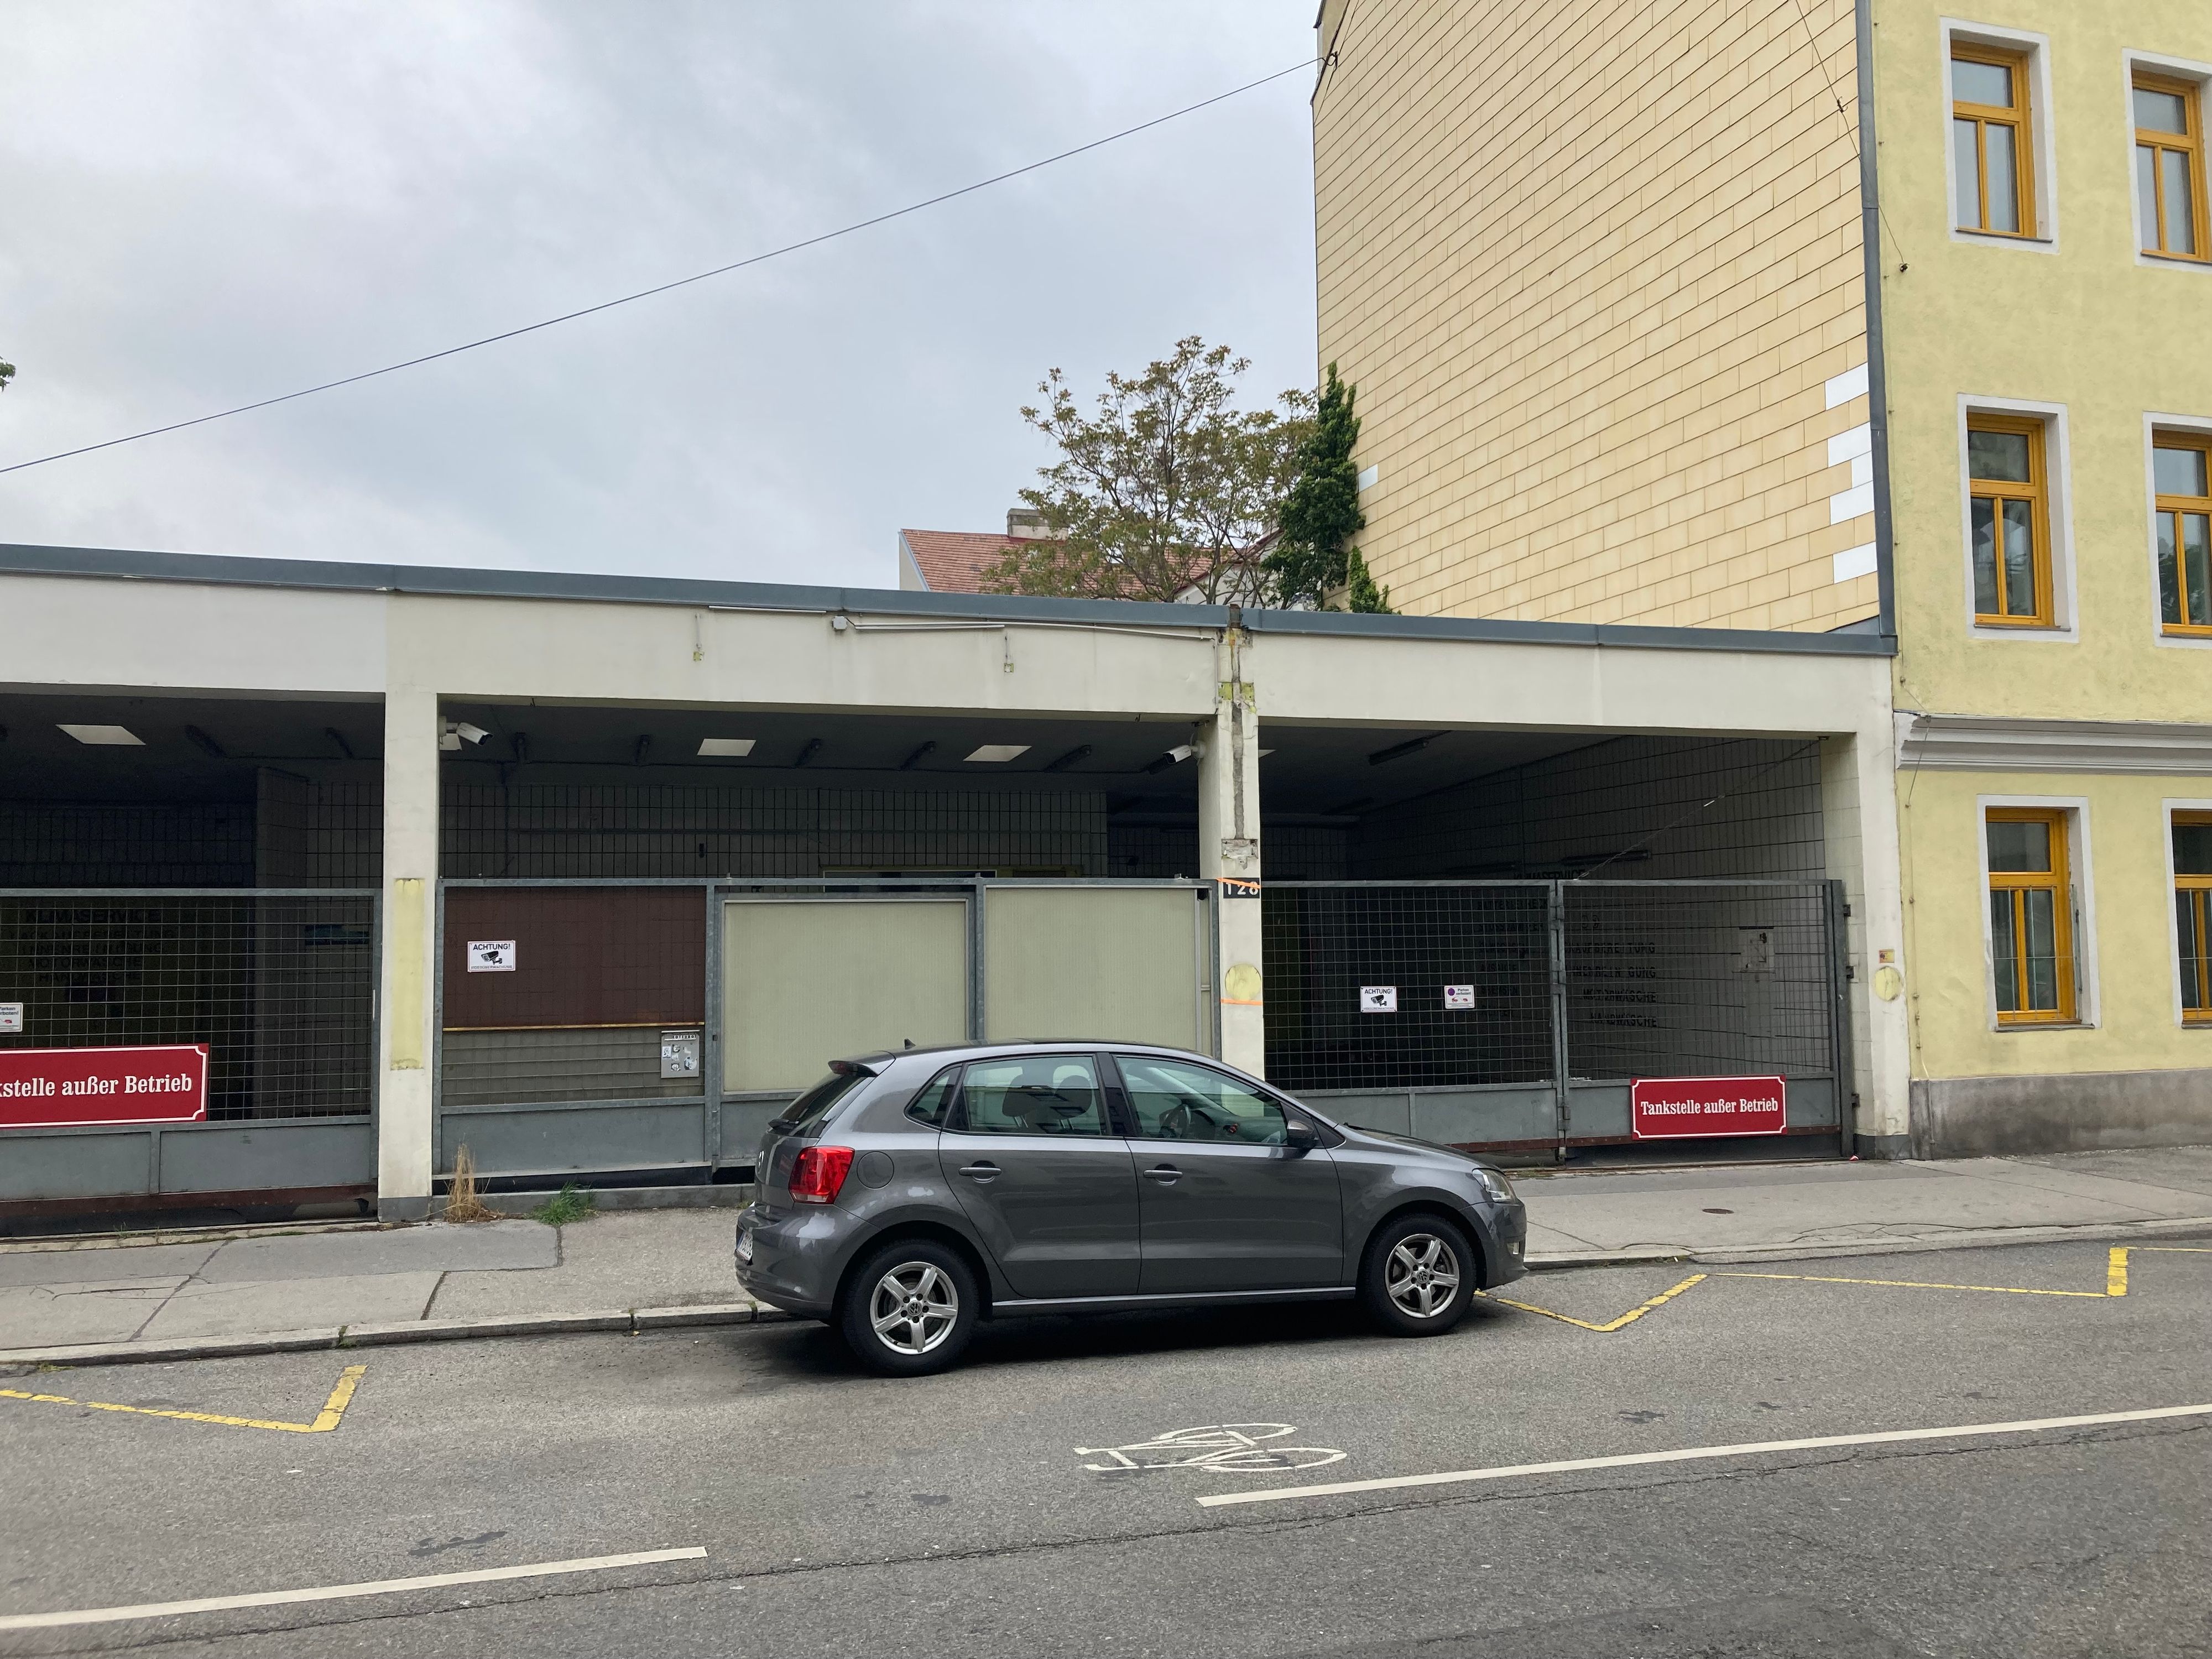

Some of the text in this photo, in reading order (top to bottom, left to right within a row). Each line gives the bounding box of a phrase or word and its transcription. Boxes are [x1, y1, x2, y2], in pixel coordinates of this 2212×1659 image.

[62, 1076, 119, 1096] außer
[124, 1073, 192, 1093] Betrieb
[1640, 1098, 1778, 1115] Tankstelle außer Betrieb
